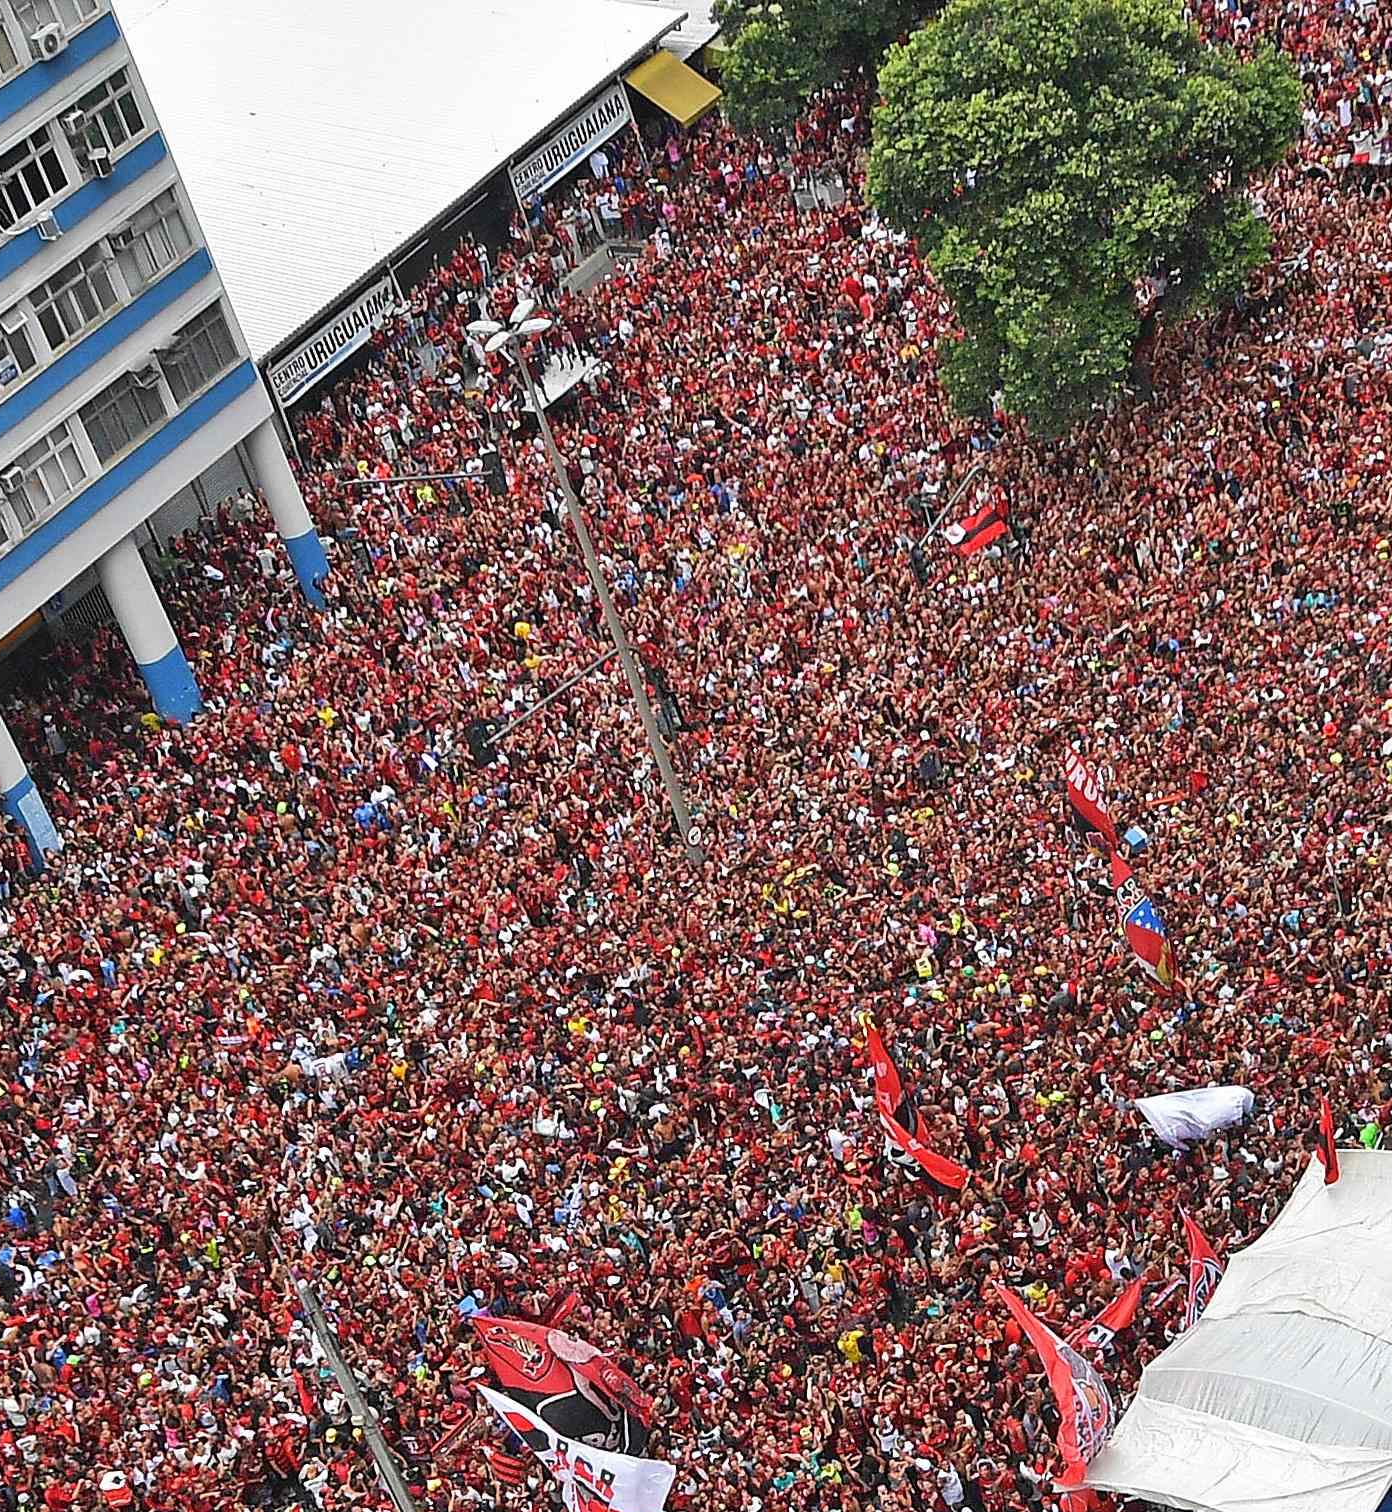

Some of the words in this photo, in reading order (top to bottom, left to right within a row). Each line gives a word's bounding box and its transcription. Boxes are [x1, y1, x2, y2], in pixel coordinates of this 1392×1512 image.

[513, 160, 544, 188] CENTRO
[543, 94, 624, 172] URUGUAIANA
[272, 356, 306, 389] CENTRO
